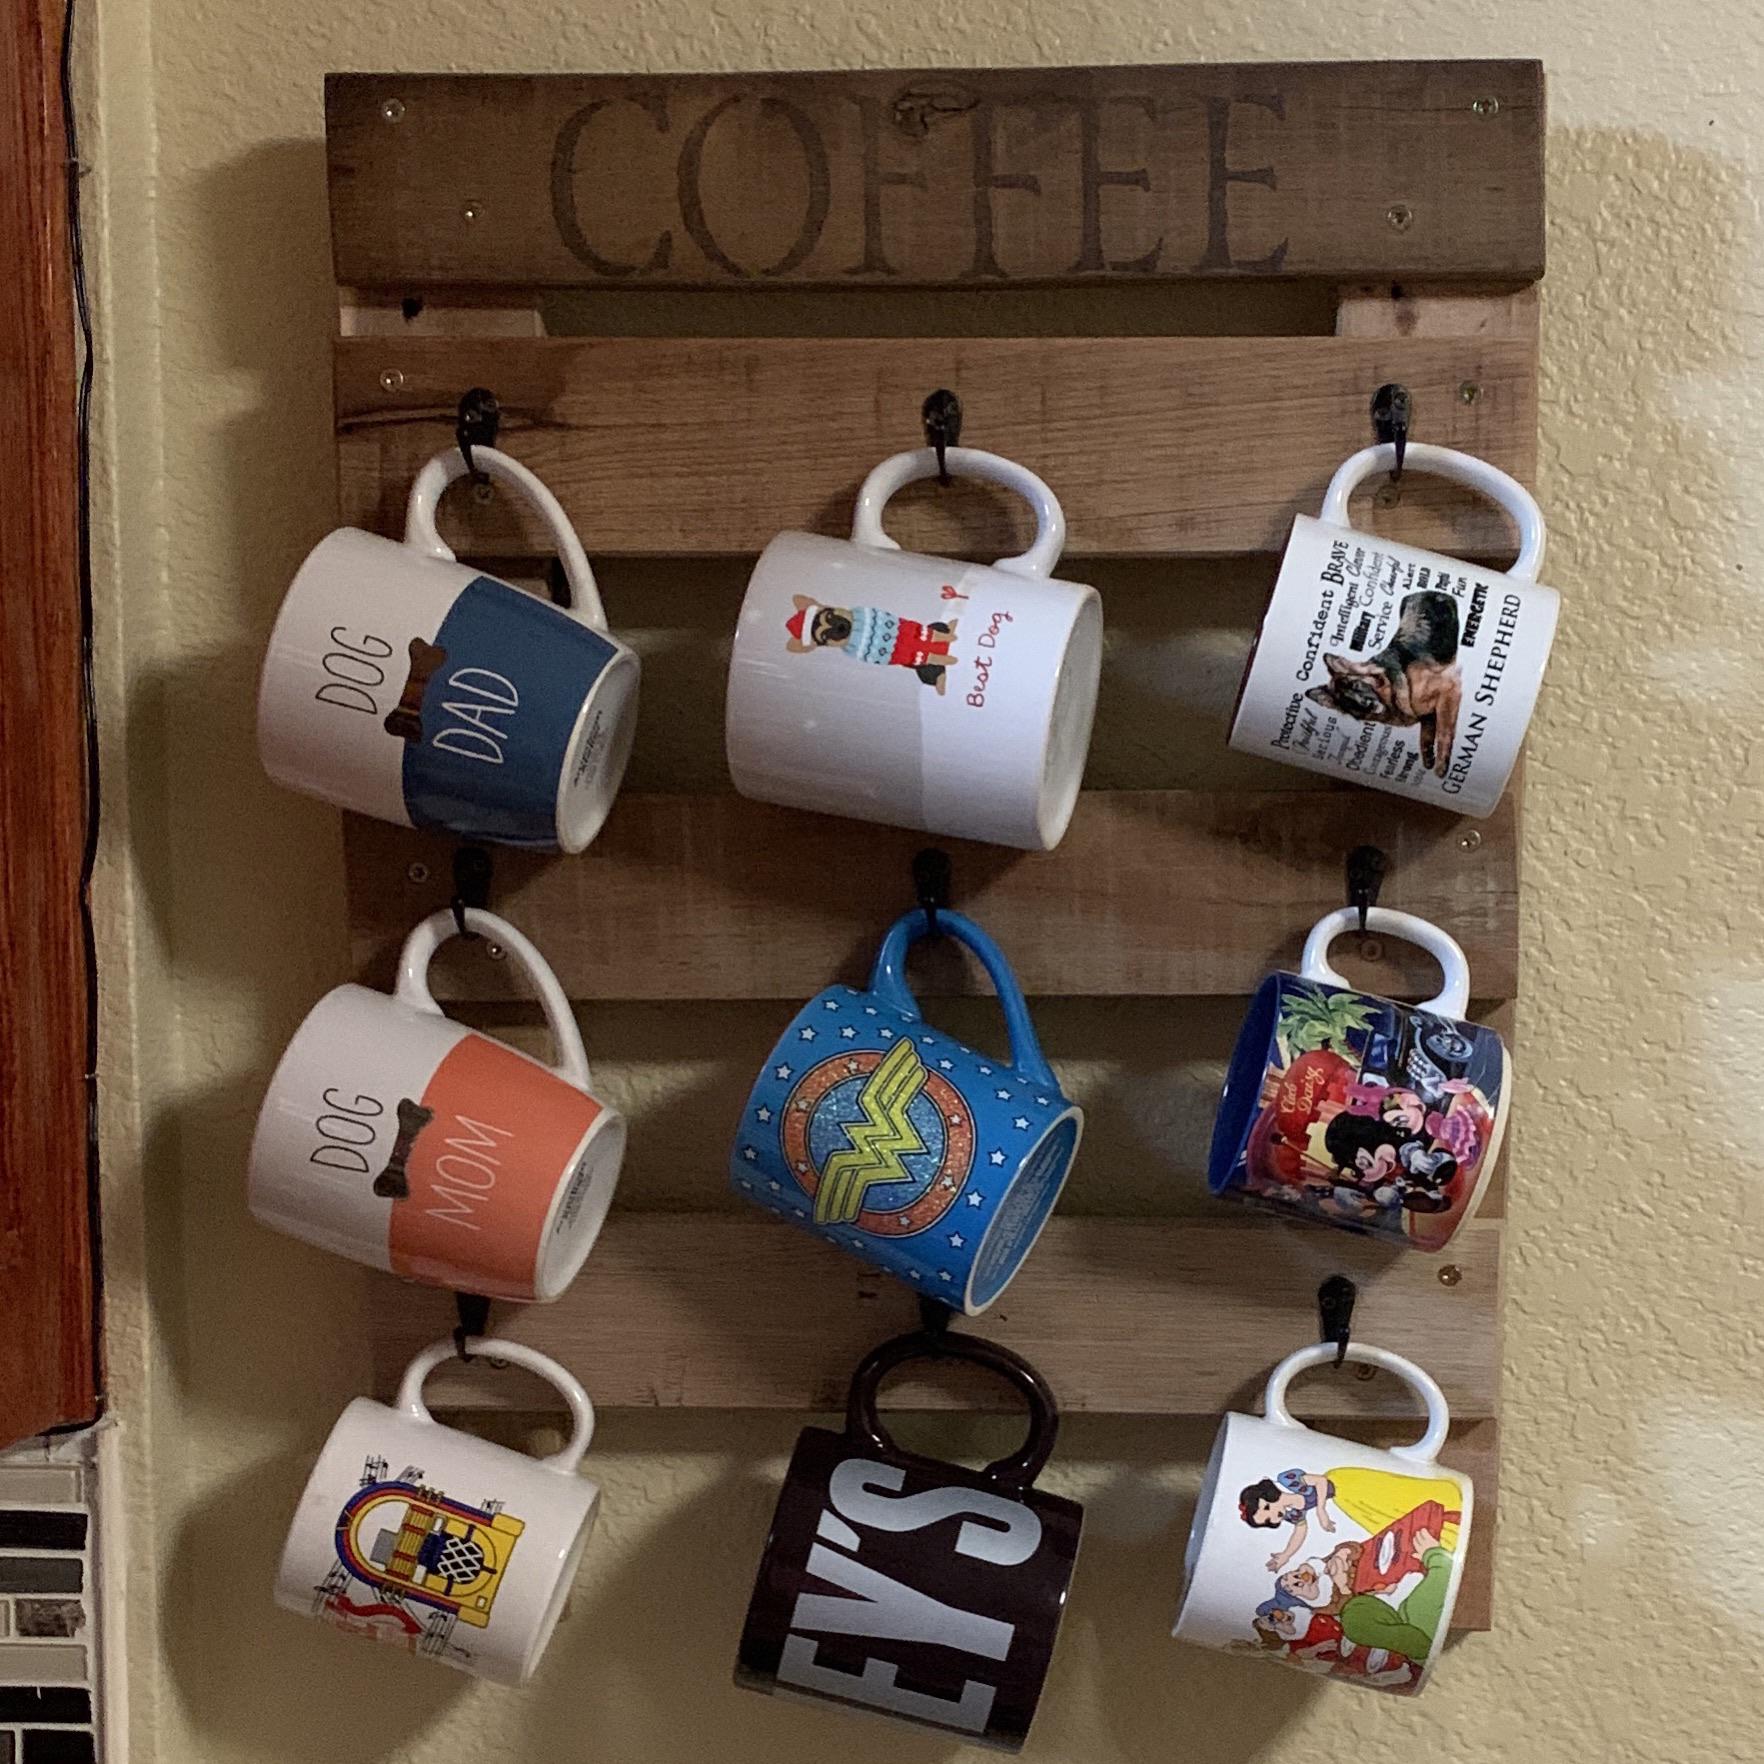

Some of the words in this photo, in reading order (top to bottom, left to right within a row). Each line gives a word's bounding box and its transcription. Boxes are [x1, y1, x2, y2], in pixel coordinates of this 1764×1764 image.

[551, 93, 1289, 279] COFFEE
[1320, 540, 1349, 586] BRAVE
[1359, 552, 1384, 607] Confident
[1452, 577, 1467, 598] Fun
[978, 610, 1013, 648] Dog
[1296, 588, 1334, 682] Confident
[1330, 582, 1359, 647] Intelligent
[1368, 601, 1393, 650] Service
[315, 626, 392, 715] DOG
[966, 656, 993, 708] Best
[1442, 712, 1488, 795] GERMAN
[1475, 594, 1521, 706] SHEPHERD
[432, 667, 519, 763] DAD
[1271, 692, 1304, 750] Protective
[1346, 721, 1376, 771] Obedient
[1296, 1066, 1324, 1114] Daisy
[310, 1088, 384, 1173] DOG
[425, 1114, 514, 1231] MOM
[776, 1458, 1042, 1733] EY'S
